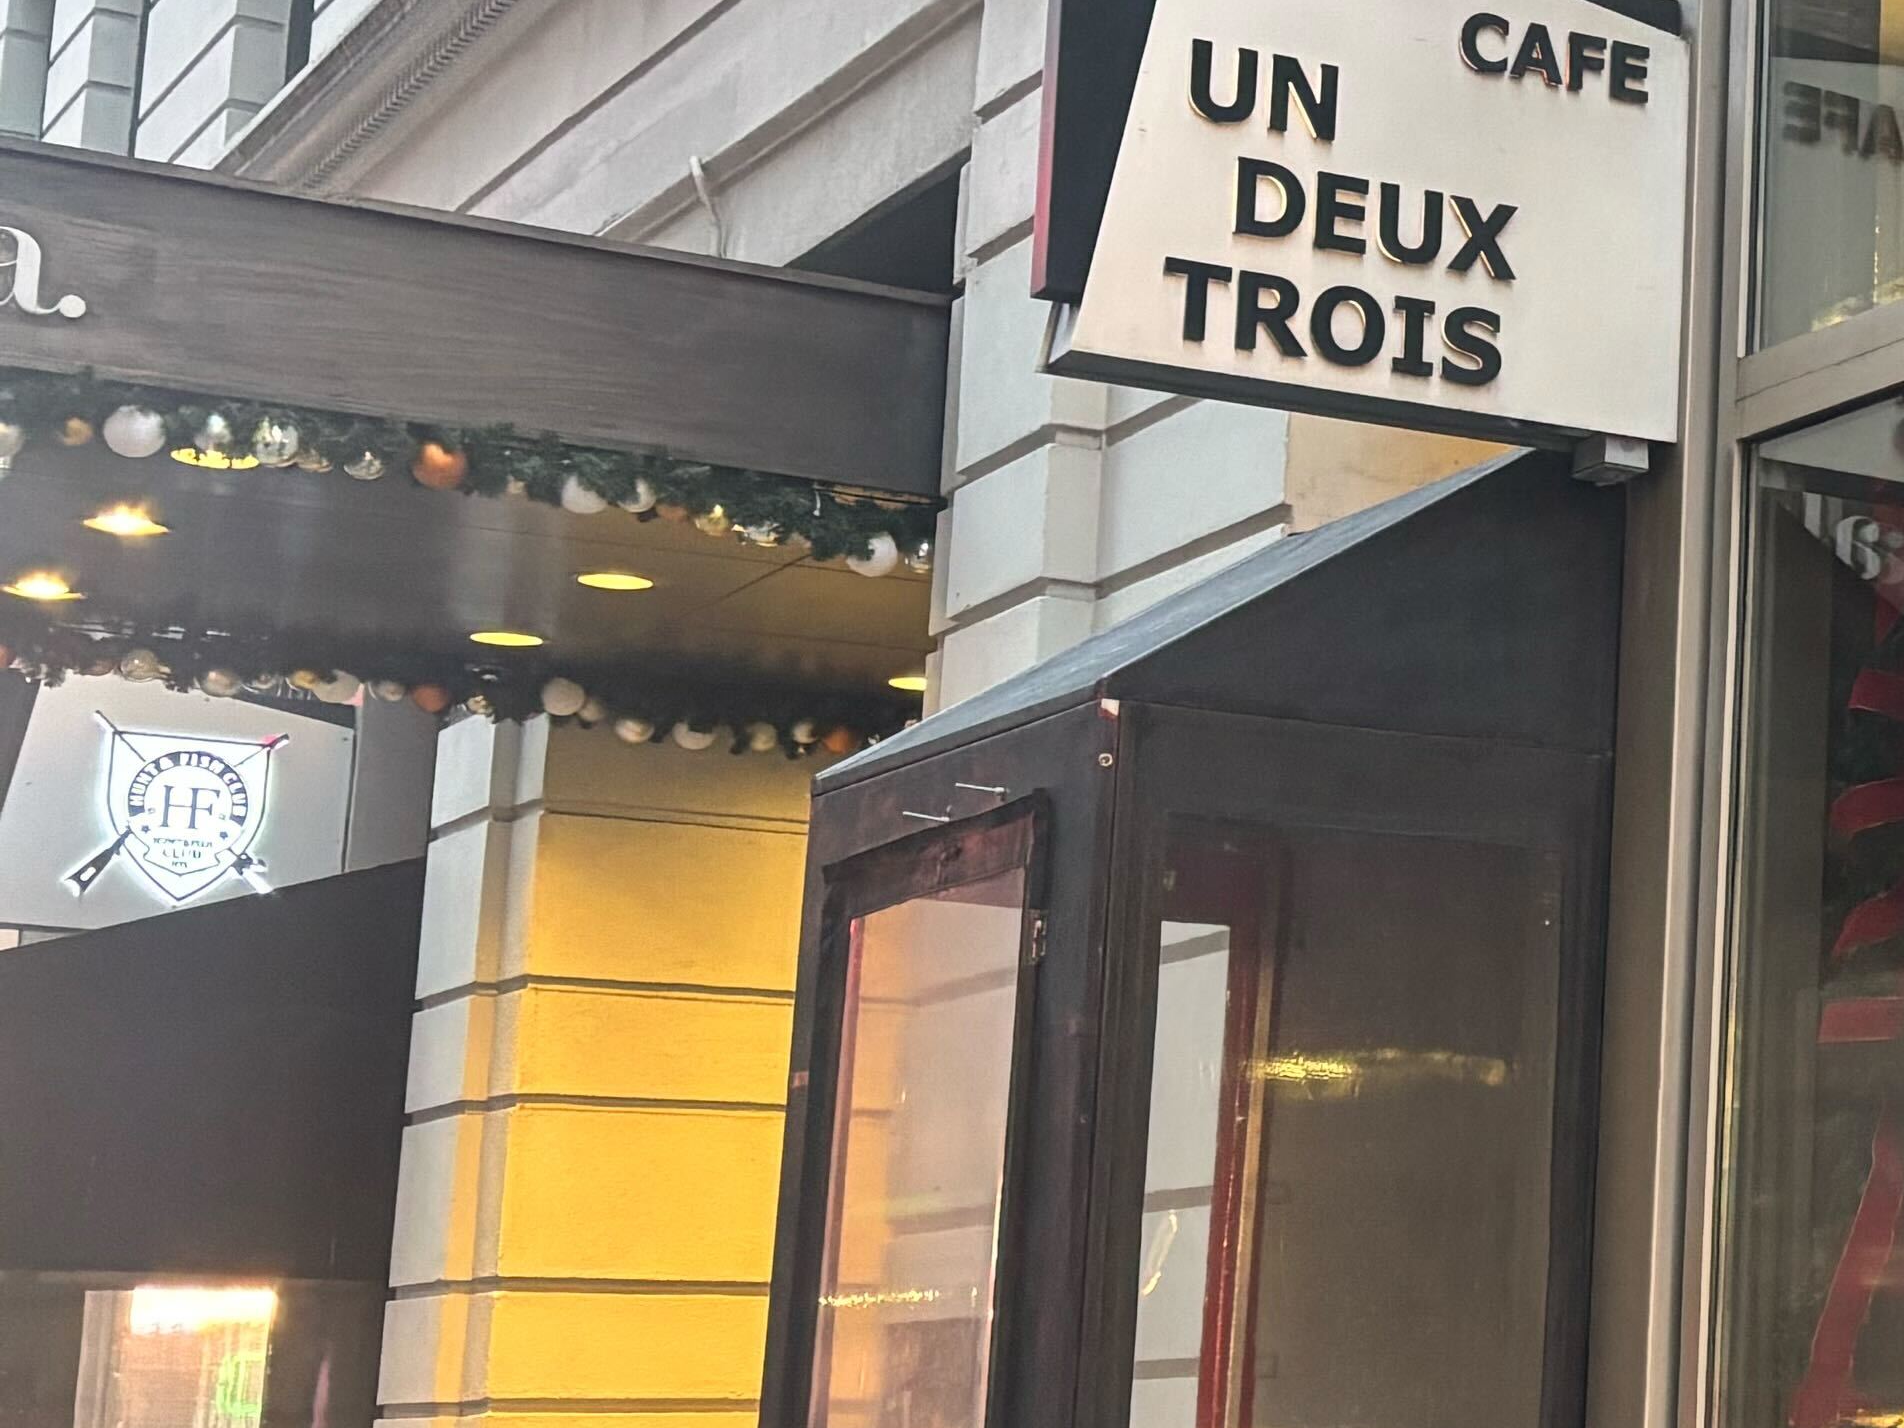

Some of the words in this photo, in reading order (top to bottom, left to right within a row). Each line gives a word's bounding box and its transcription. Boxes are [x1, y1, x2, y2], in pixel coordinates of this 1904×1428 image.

[1187, 38, 1340, 141] UN
[1459, 12, 1651, 105] CAFE
[1231, 156, 1519, 281] DEUX
[1163, 256, 1503, 386] TROIS
